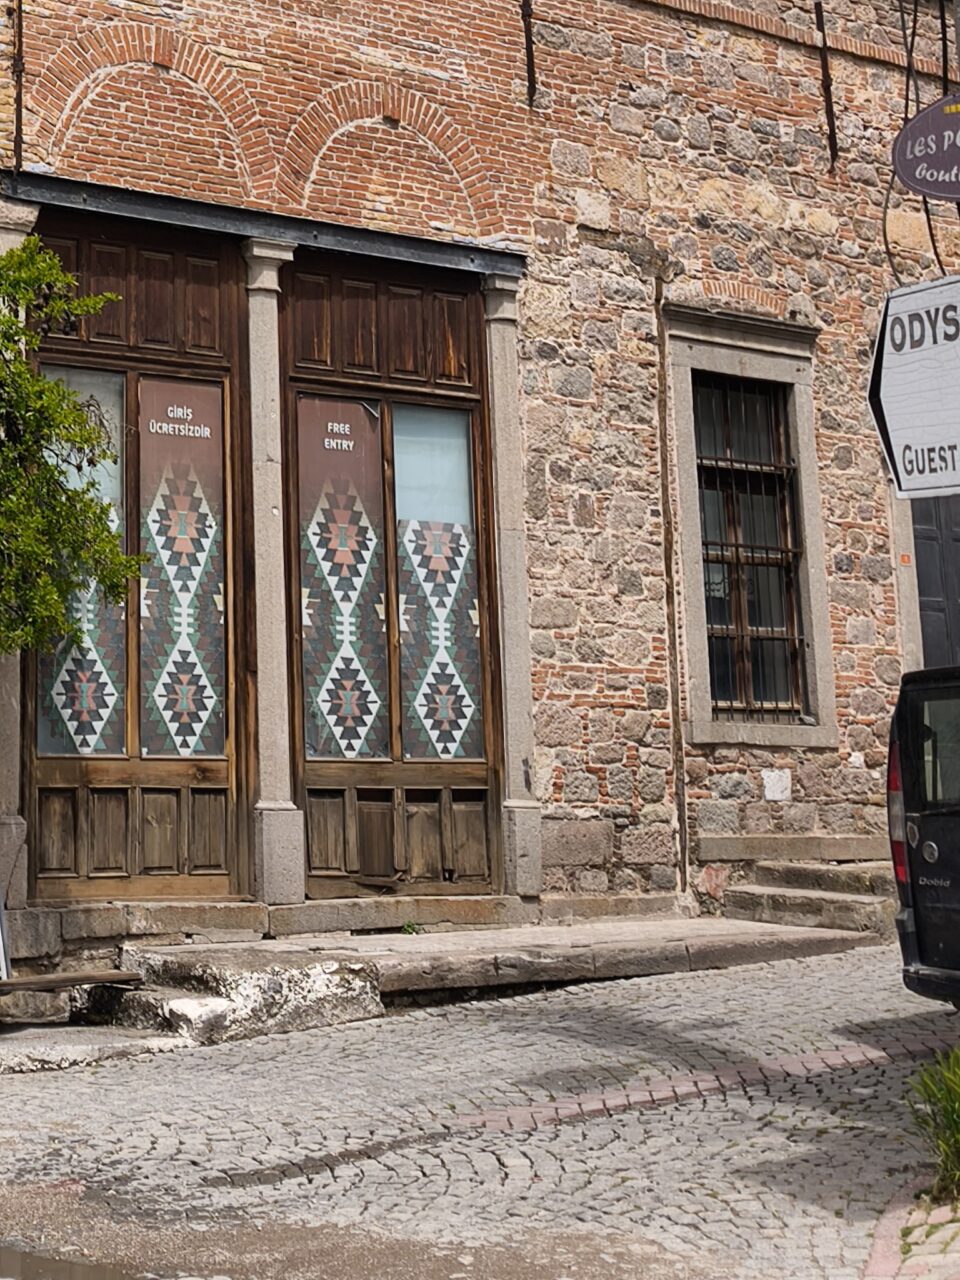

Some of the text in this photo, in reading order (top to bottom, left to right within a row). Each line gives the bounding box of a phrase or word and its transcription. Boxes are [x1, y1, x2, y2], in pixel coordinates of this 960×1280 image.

[905, 134, 936, 160] LES
[915, 163, 960, 183] bout
[167, 404, 193, 421] GİRİŞ
[148, 419, 212, 439] ÜCRETSİZDİR
[327, 422, 351, 436] FREE
[323, 438, 354, 452] ENTRY
[902, 443, 958, 476] GUEST
